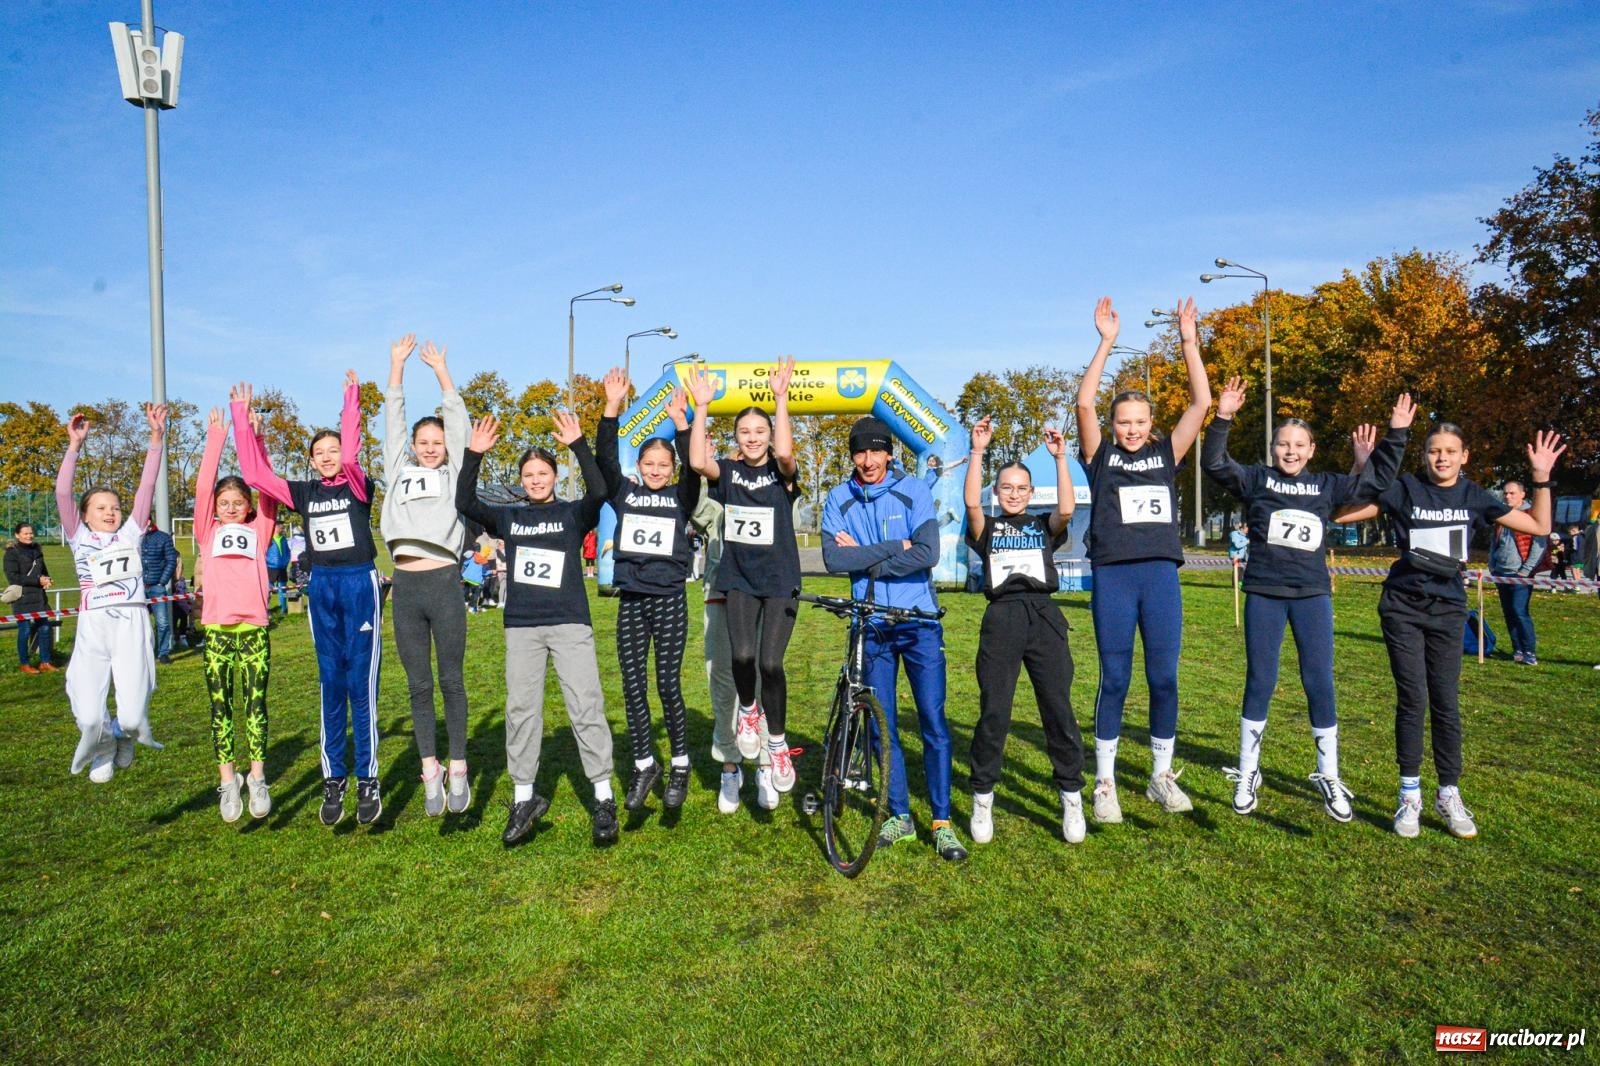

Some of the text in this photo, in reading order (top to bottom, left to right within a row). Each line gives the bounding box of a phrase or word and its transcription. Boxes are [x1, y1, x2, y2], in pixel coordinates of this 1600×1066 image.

[753, 368, 810, 376] Gmna
[738, 378, 825, 389] Pietwice
[750, 391, 814, 402] Wikie
[891, 378, 950, 434] Gmina ludzi
[618, 407, 650, 437] Gmina
[630, 405, 669, 448] aktywn
[881, 391, 935, 444] aktywnych
[401, 477, 426, 494] 71
[1266, 477, 1321, 496] HANDBALL
[1132, 499, 1162, 515] 75
[315, 527, 340, 545] 81
[510, 521, 564, 536] HANDBALL
[734, 519, 762, 537] 73
[1282, 522, 1311, 542] 78
[221, 534, 248, 550] 69
[633, 529, 662, 547] 64
[992, 537, 1046, 549] HANDBALL
[100, 556, 129, 575] 77
[523, 561, 551, 580] 82
